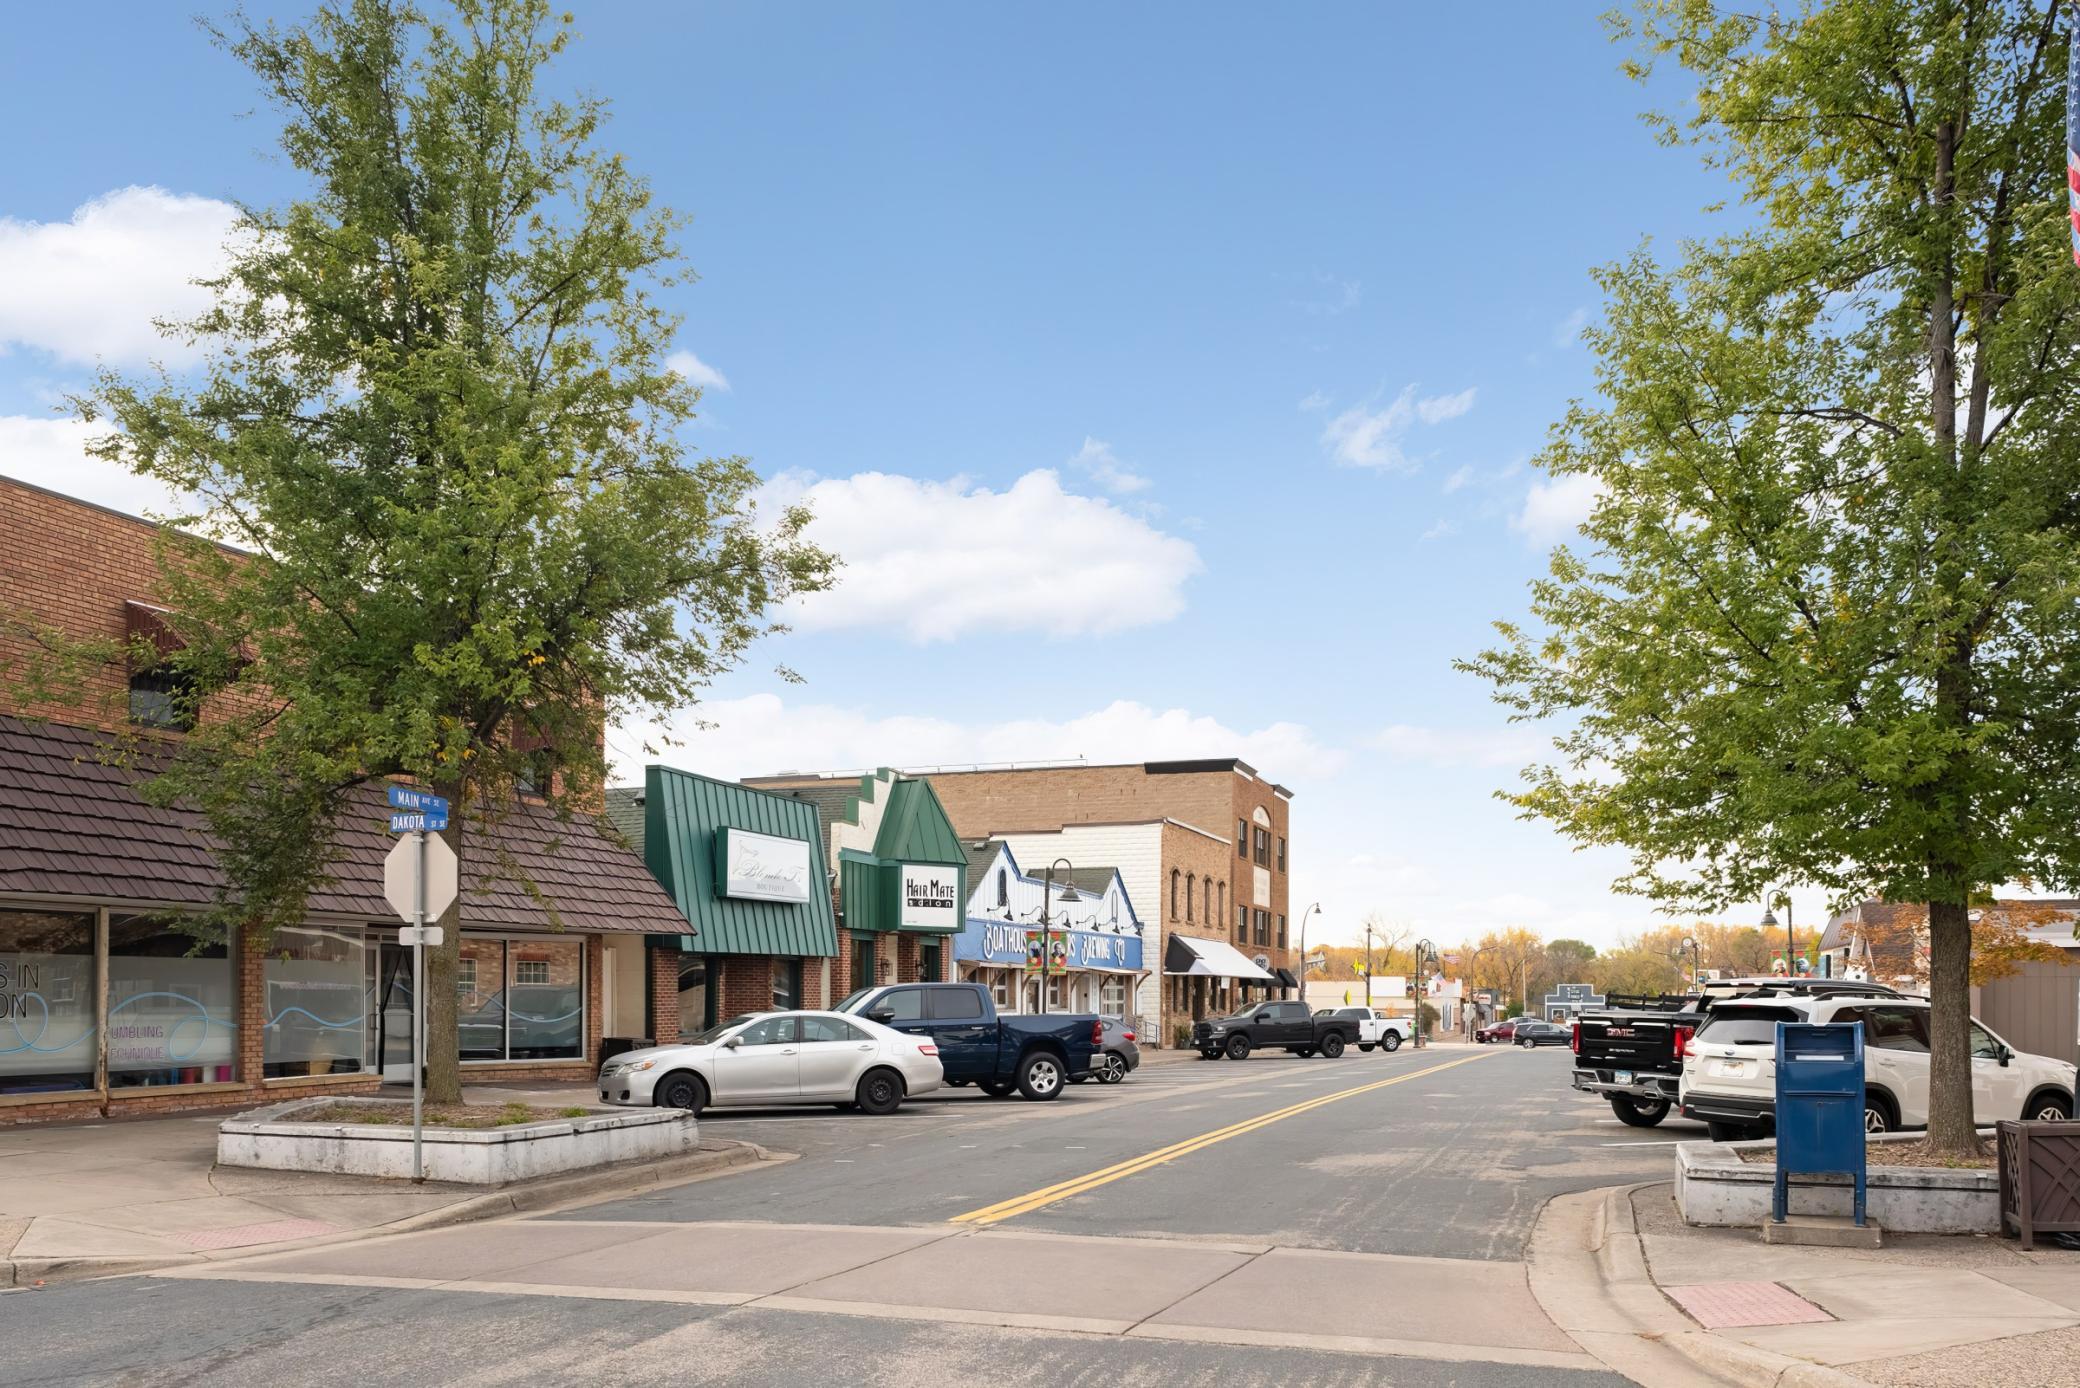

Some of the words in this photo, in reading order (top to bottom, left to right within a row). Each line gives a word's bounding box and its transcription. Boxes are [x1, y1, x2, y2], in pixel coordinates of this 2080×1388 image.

[398, 791, 419, 808] MAIN
[392, 815, 425, 829] DAKOTA
[983, 923, 1027, 959] BOATHOUS
[18, 964, 39, 989] IN
[110, 1025, 164, 1039] UMBLING
[1606, 1027, 1635, 1037] GMC
[110, 1047, 165, 1060] ECHNIQUE
